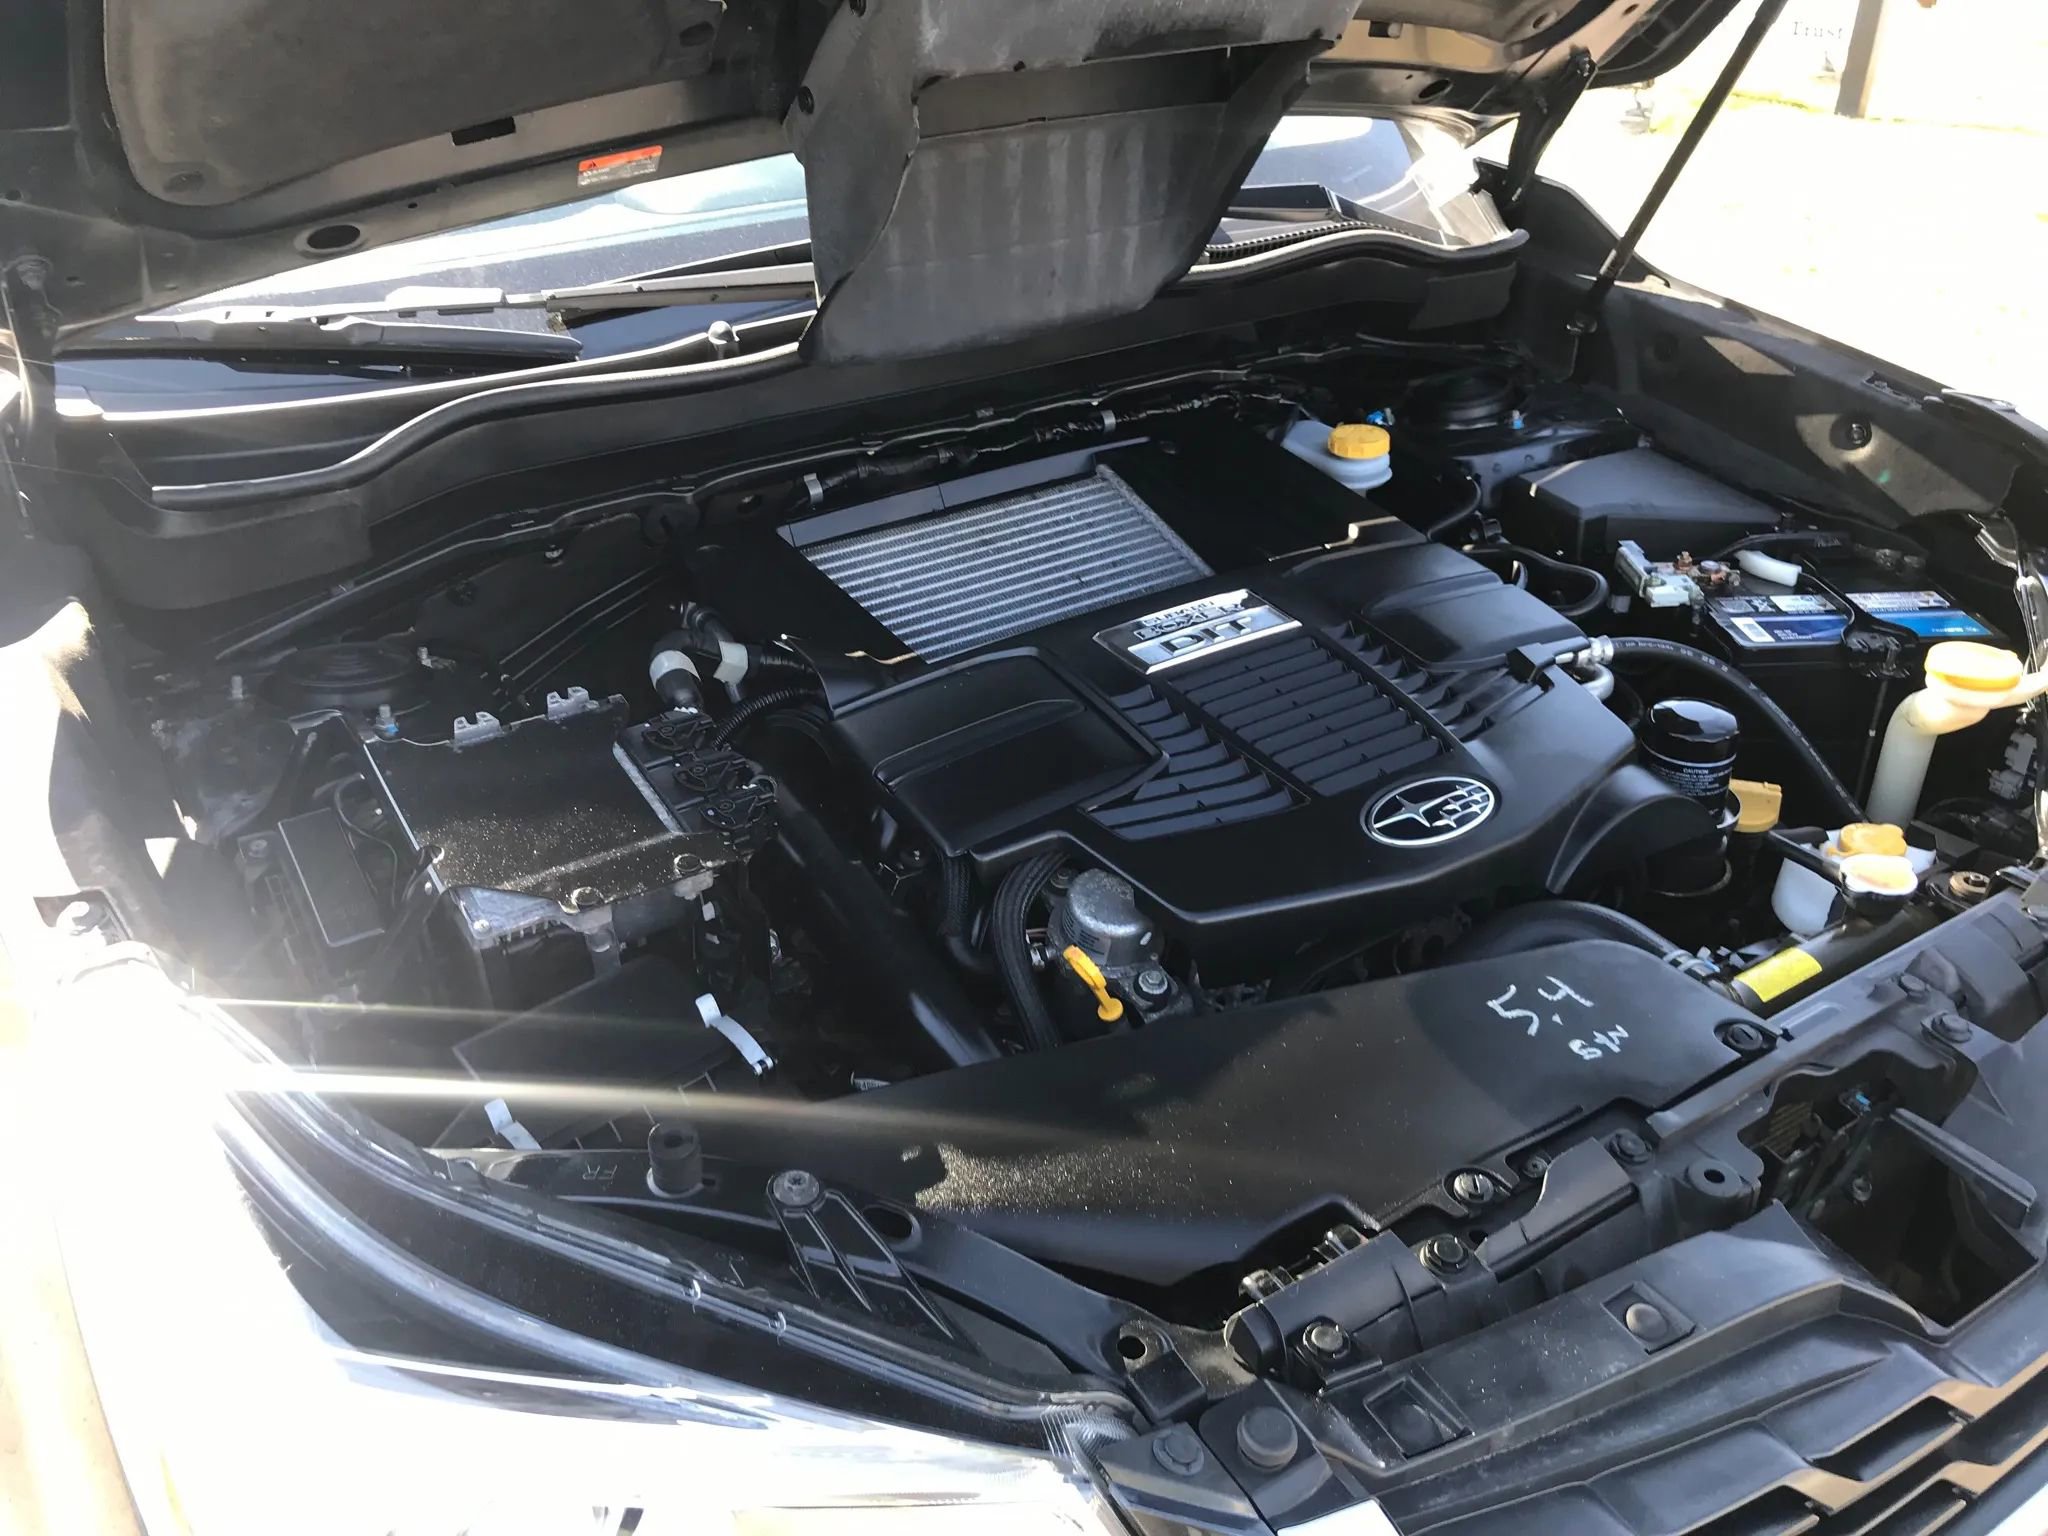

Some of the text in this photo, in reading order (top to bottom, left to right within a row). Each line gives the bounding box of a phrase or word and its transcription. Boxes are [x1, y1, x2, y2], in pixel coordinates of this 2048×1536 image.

[1133, 602, 1246, 640] BOXER
[1142, 600, 1216, 627] SUBARU
[1159, 617, 1252, 654] DIT
[1682, 767, 1709, 775] CAUTION
[1486, 975, 1595, 1036] 5.4
